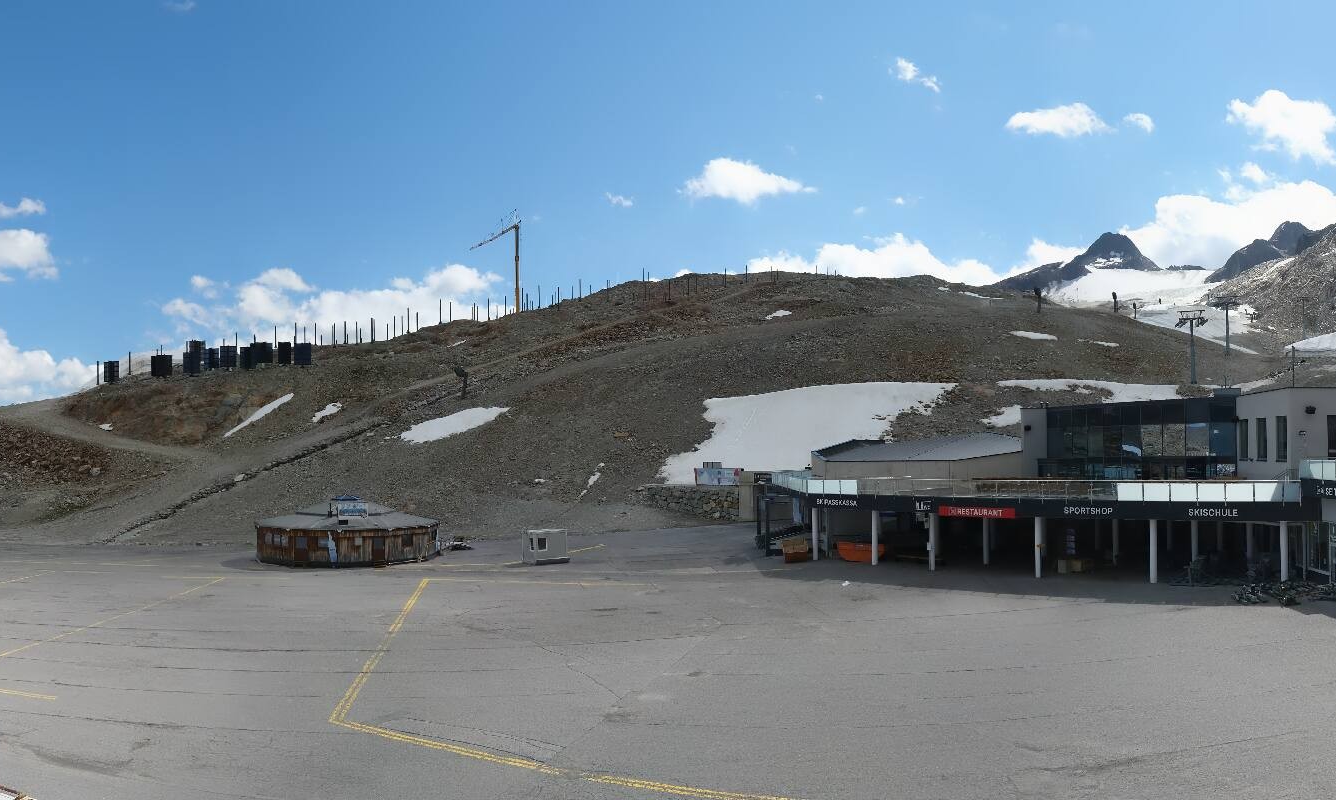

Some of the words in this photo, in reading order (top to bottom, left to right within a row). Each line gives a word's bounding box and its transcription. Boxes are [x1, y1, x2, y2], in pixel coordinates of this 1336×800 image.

[816, 498, 858, 507] SKPASSKASSA
[957, 507, 1003, 517] RESTAURANT
[1063, 506, 1113, 516] SPORTSHOP
[1188, 508, 1239, 517] SKISCHULE
